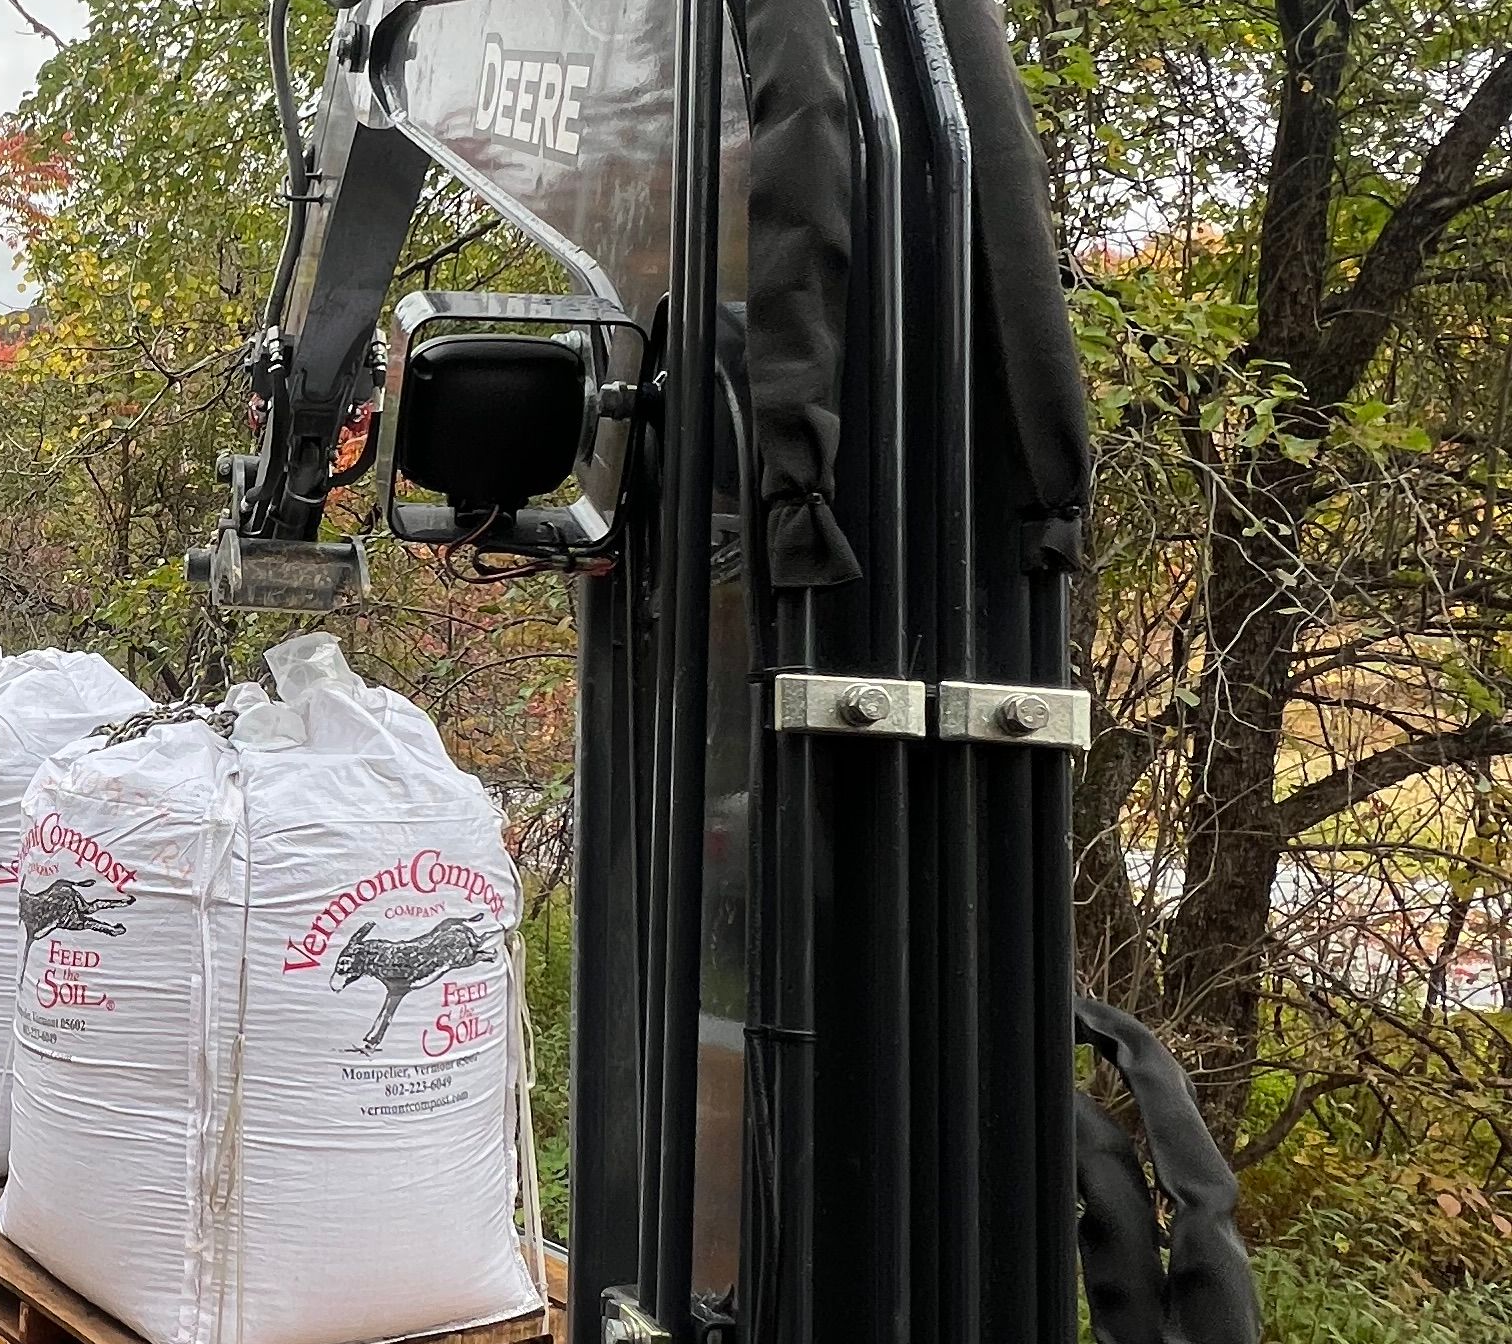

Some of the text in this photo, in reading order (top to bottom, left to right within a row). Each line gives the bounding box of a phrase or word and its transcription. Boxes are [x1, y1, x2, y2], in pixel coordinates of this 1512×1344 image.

[475, 40, 591, 156] DEERE
[40, 812, 138, 894] Compost
[384, 901, 447, 920] COMPANY
[48, 939, 100, 968] FEED
[63, 967, 80, 981] the
[36, 968, 107, 1009] SOIL
[441, 980, 488, 1007] FEED
[422, 1010, 491, 1057] SOIL
[341, 1066, 411, 1083] Montpelier,
[384, 1075, 453, 1097] 802-223-6049
